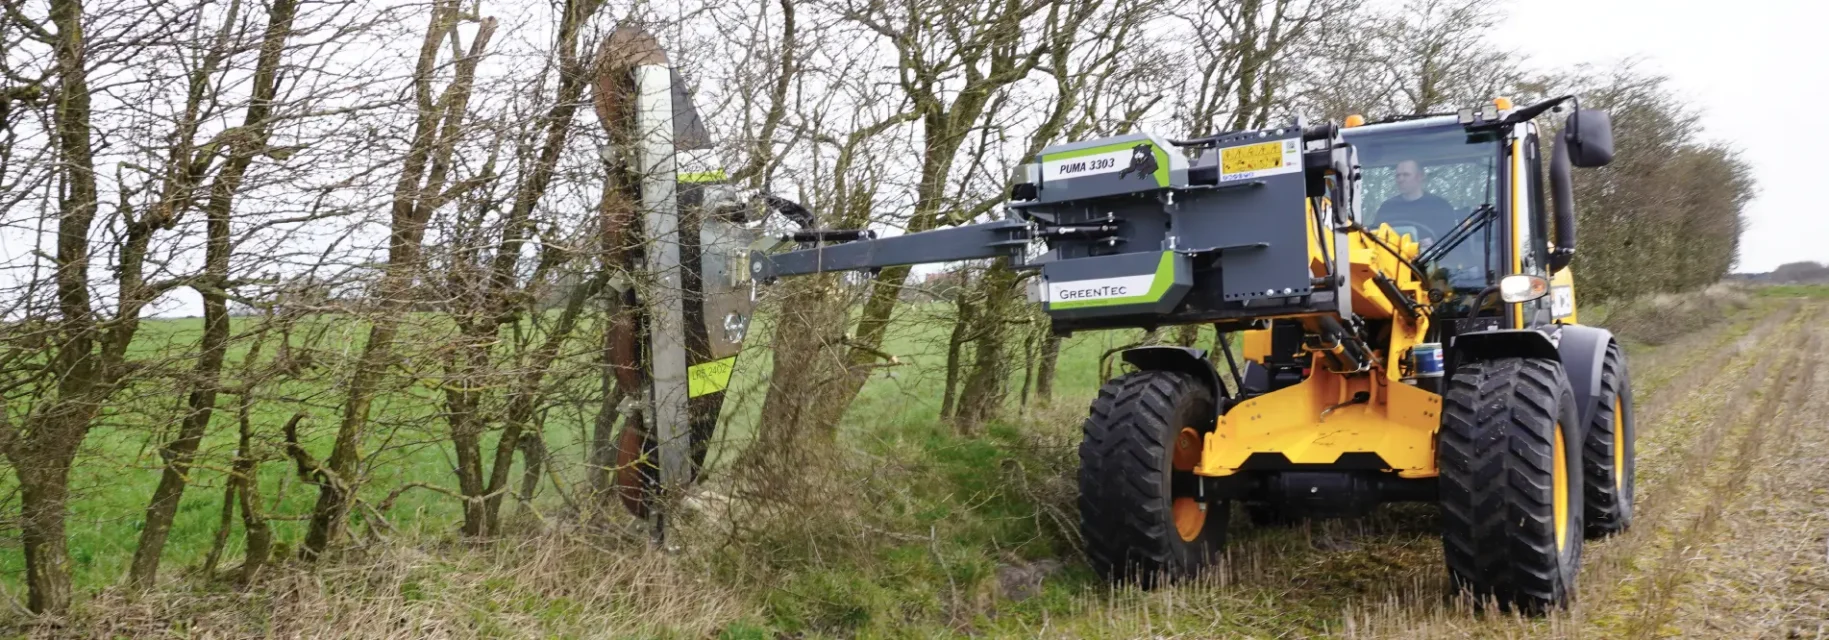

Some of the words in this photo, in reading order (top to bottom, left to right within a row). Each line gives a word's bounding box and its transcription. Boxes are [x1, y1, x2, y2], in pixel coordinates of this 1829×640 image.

[1060, 162, 1086, 174] PUMA
[1089, 158, 1115, 170] 3303
[708, 363, 727, 376] 2402
